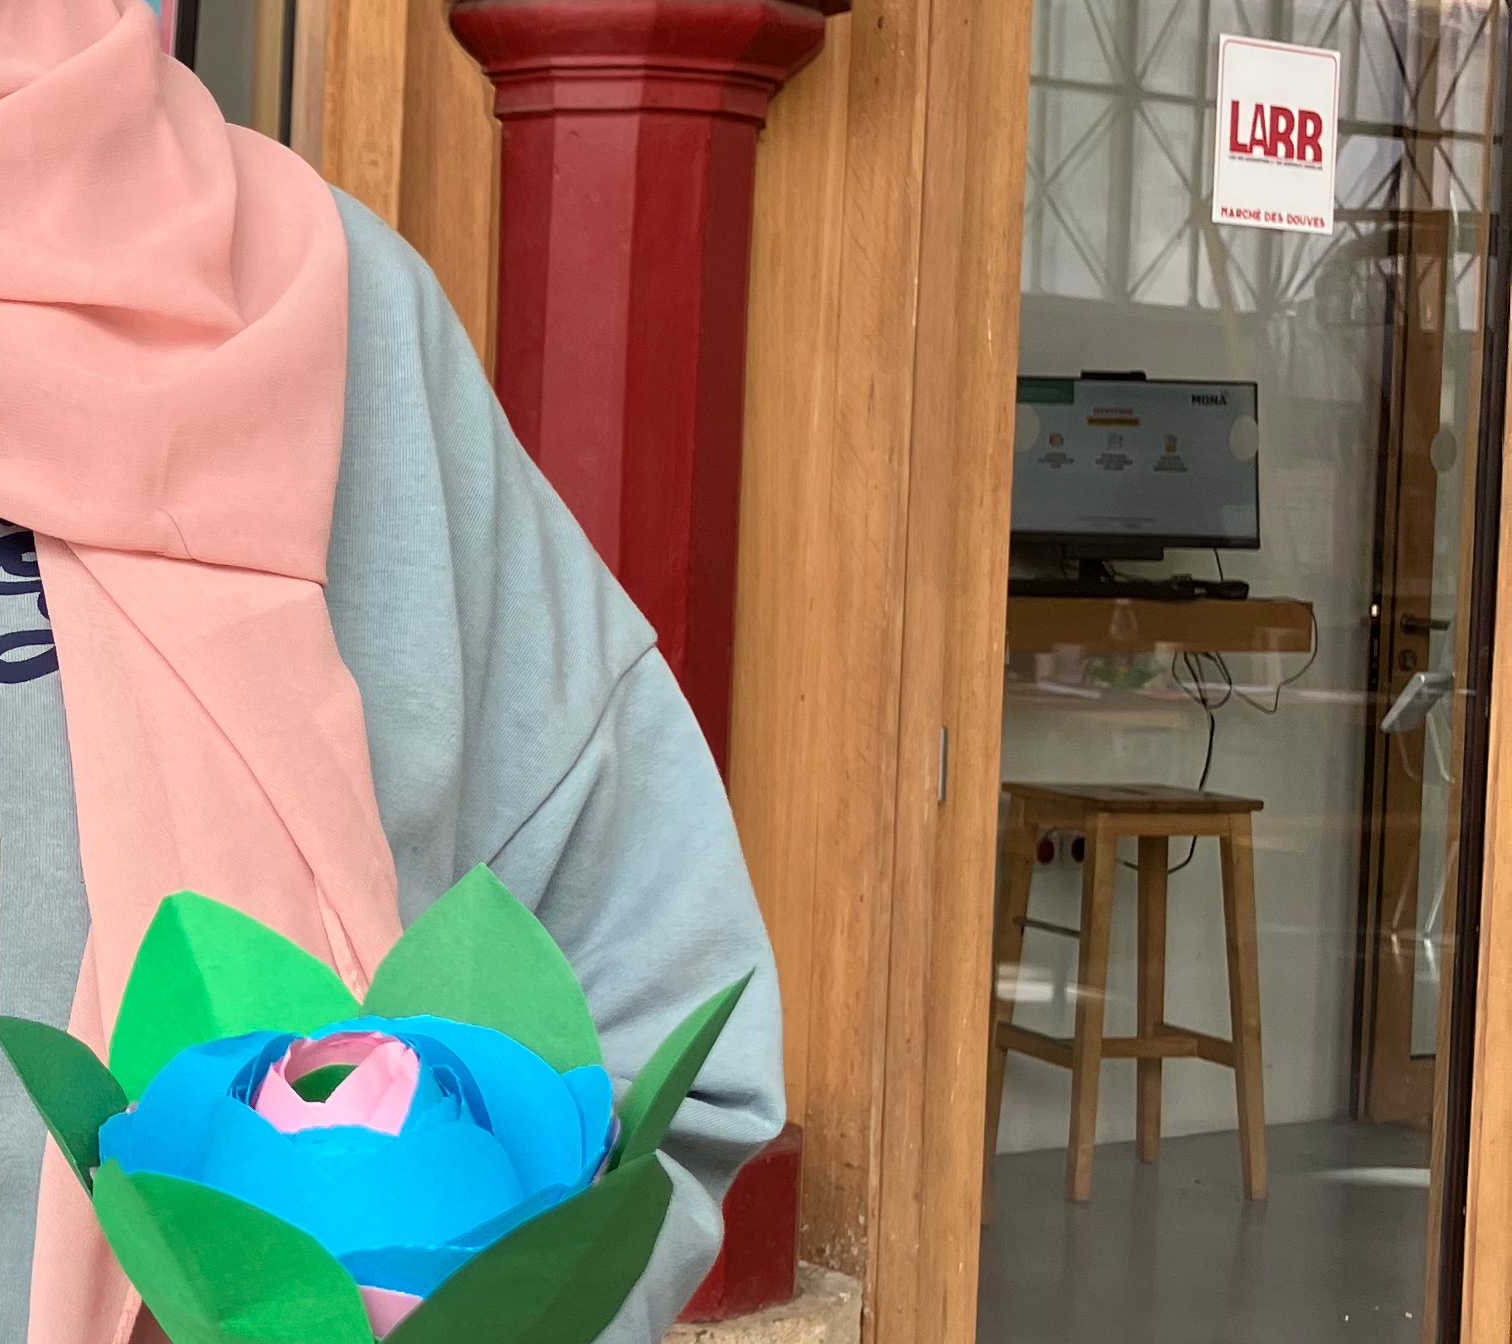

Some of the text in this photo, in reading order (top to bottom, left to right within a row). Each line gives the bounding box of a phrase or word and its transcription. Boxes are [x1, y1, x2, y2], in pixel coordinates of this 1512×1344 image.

[1229, 99, 1323, 163] LARR
[1221, 206, 1325, 229] MARCHÉ DES DOUVES
